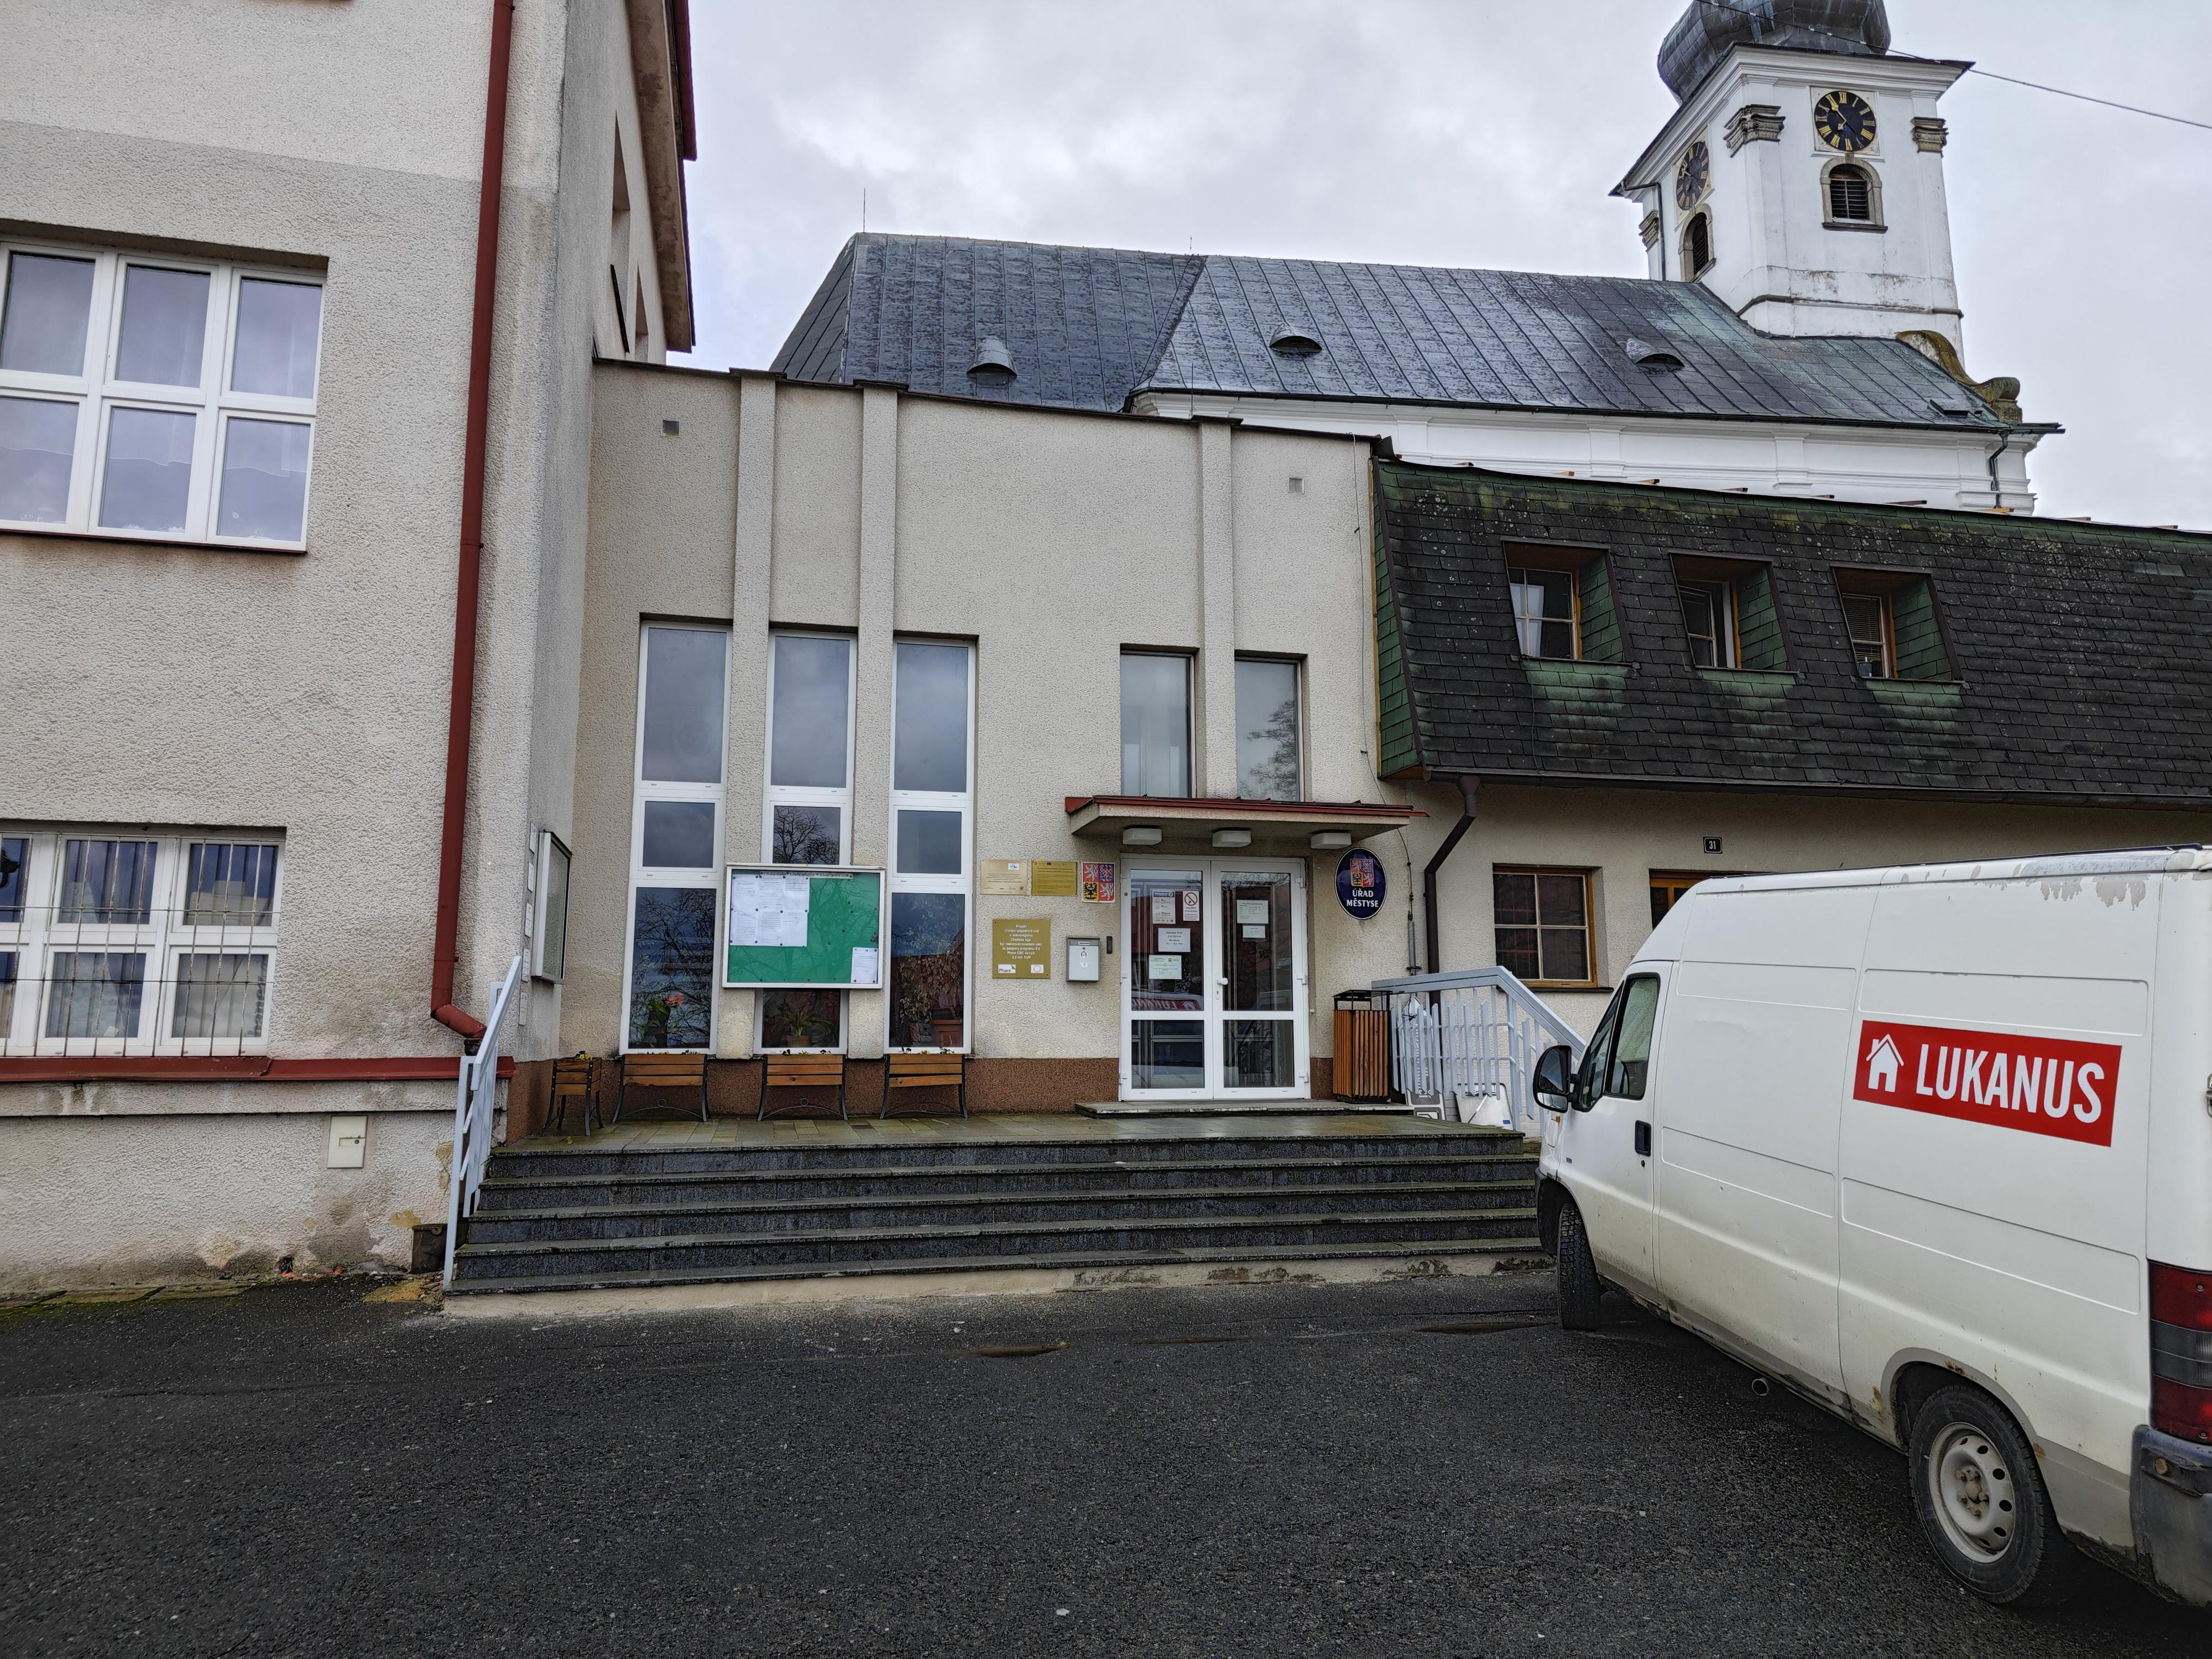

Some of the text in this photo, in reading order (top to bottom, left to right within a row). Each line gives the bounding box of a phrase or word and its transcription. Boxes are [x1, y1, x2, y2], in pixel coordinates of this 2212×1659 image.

[1709, 841, 1716, 849] 31
[1352, 888, 1374, 898] ÚŘAD
[1347, 898, 1379, 907] MĚSTYSE
[1916, 1044, 2105, 1124] LUKANUS
